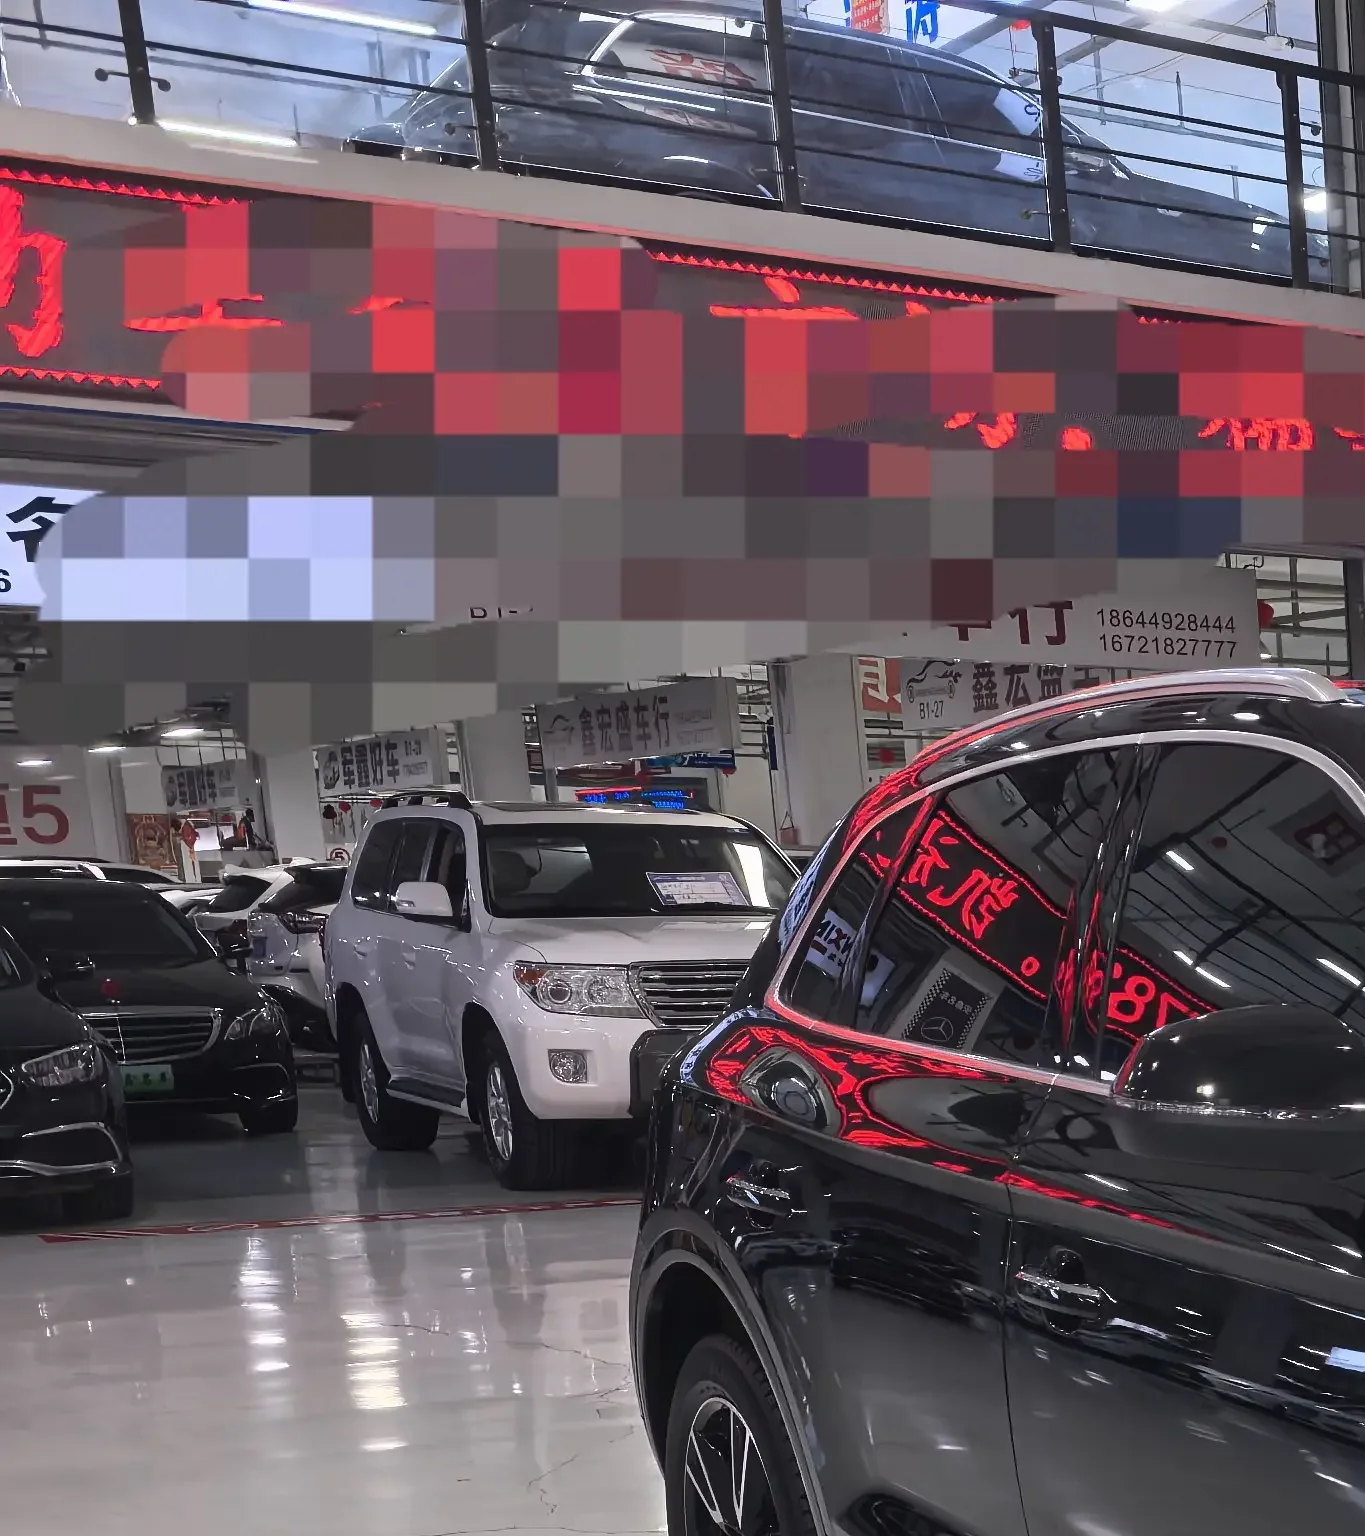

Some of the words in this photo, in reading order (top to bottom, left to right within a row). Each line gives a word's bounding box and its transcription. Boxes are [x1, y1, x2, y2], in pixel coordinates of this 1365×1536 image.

[1096, 609, 1236, 634] 18644928444
[1098, 633, 1238, 659] 16721827777
[919, 700, 944, 720] B1-27
